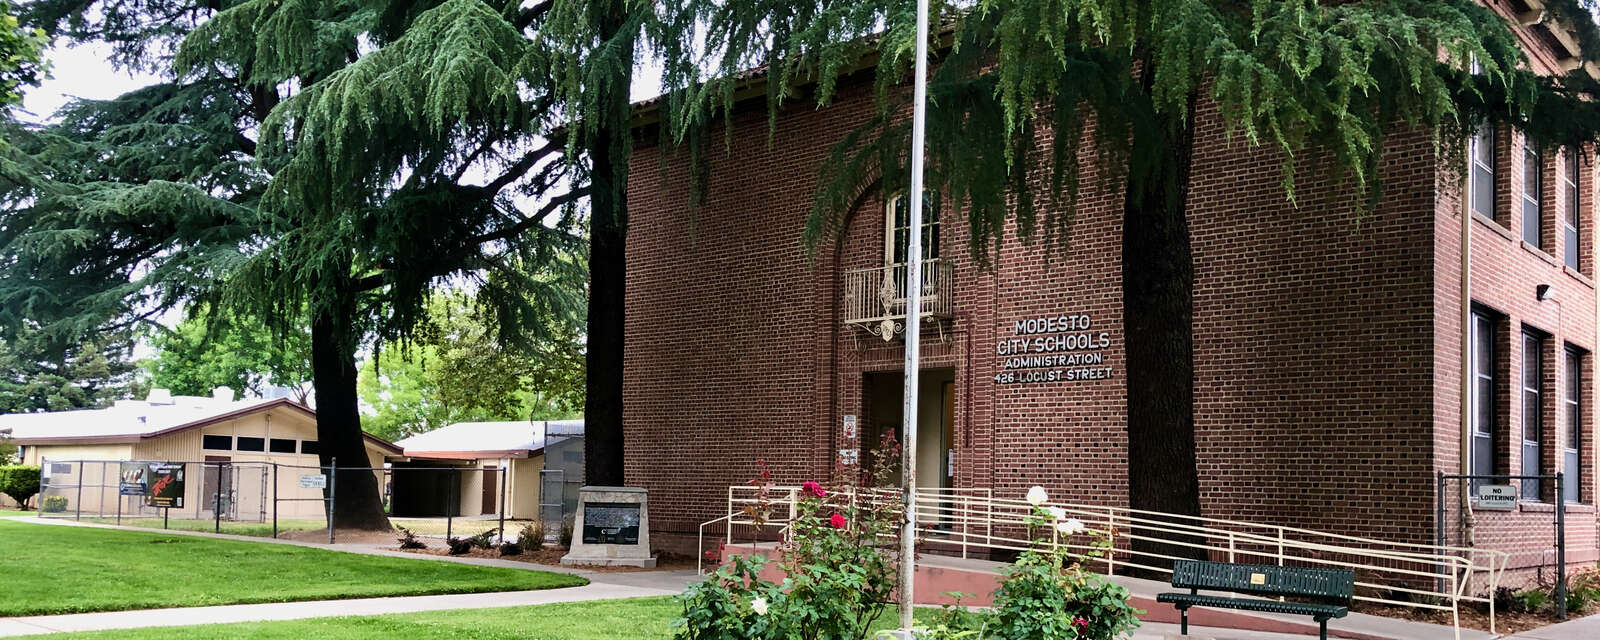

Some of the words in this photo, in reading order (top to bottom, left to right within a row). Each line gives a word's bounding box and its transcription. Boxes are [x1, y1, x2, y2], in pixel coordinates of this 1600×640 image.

[1015, 315, 1090, 335] MODESTO
[997, 338, 1030, 355] CITY
[1035, 333, 1110, 352] SCHOOLS
[1005, 353, 1102, 368] ADMINISTRATION
[994, 372, 1014, 384] 426
[1019, 370, 1063, 383] LOCUST
[1067, 367, 1113, 380] STREET
